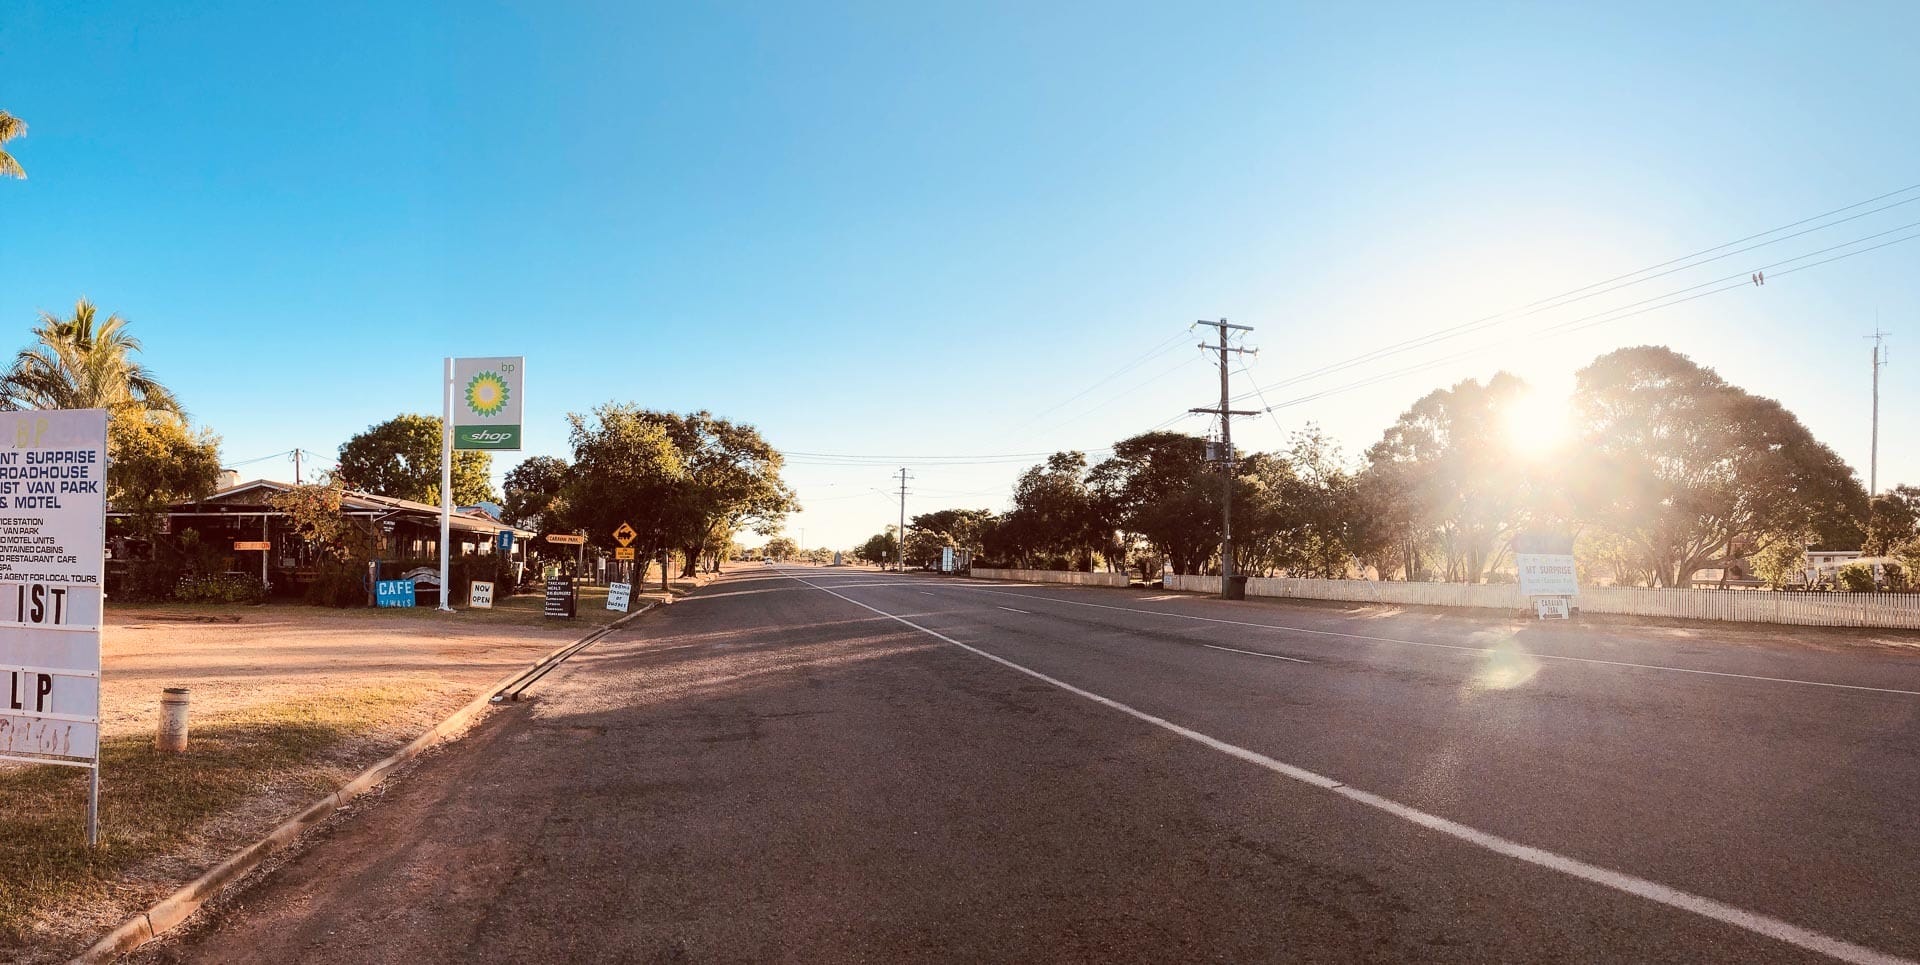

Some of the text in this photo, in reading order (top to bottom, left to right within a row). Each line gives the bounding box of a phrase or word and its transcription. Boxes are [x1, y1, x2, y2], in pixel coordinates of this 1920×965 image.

[501, 362, 515, 373] bp
[16, 416, 48, 449] BP
[471, 430, 512, 444] shop
[0, 450, 96, 464] NT SURPRISE
[0, 466, 88, 479] ROADHOUSE
[0, 480, 98, 494] IST VAN PARK
[0, 496, 62, 508] & MOTEL
[1540, 566, 1572, 574] SURPRISE
[70, 574, 96, 582] TOURS
[379, 582, 412, 595] CAFE
[472, 596, 490, 604] OPEN
